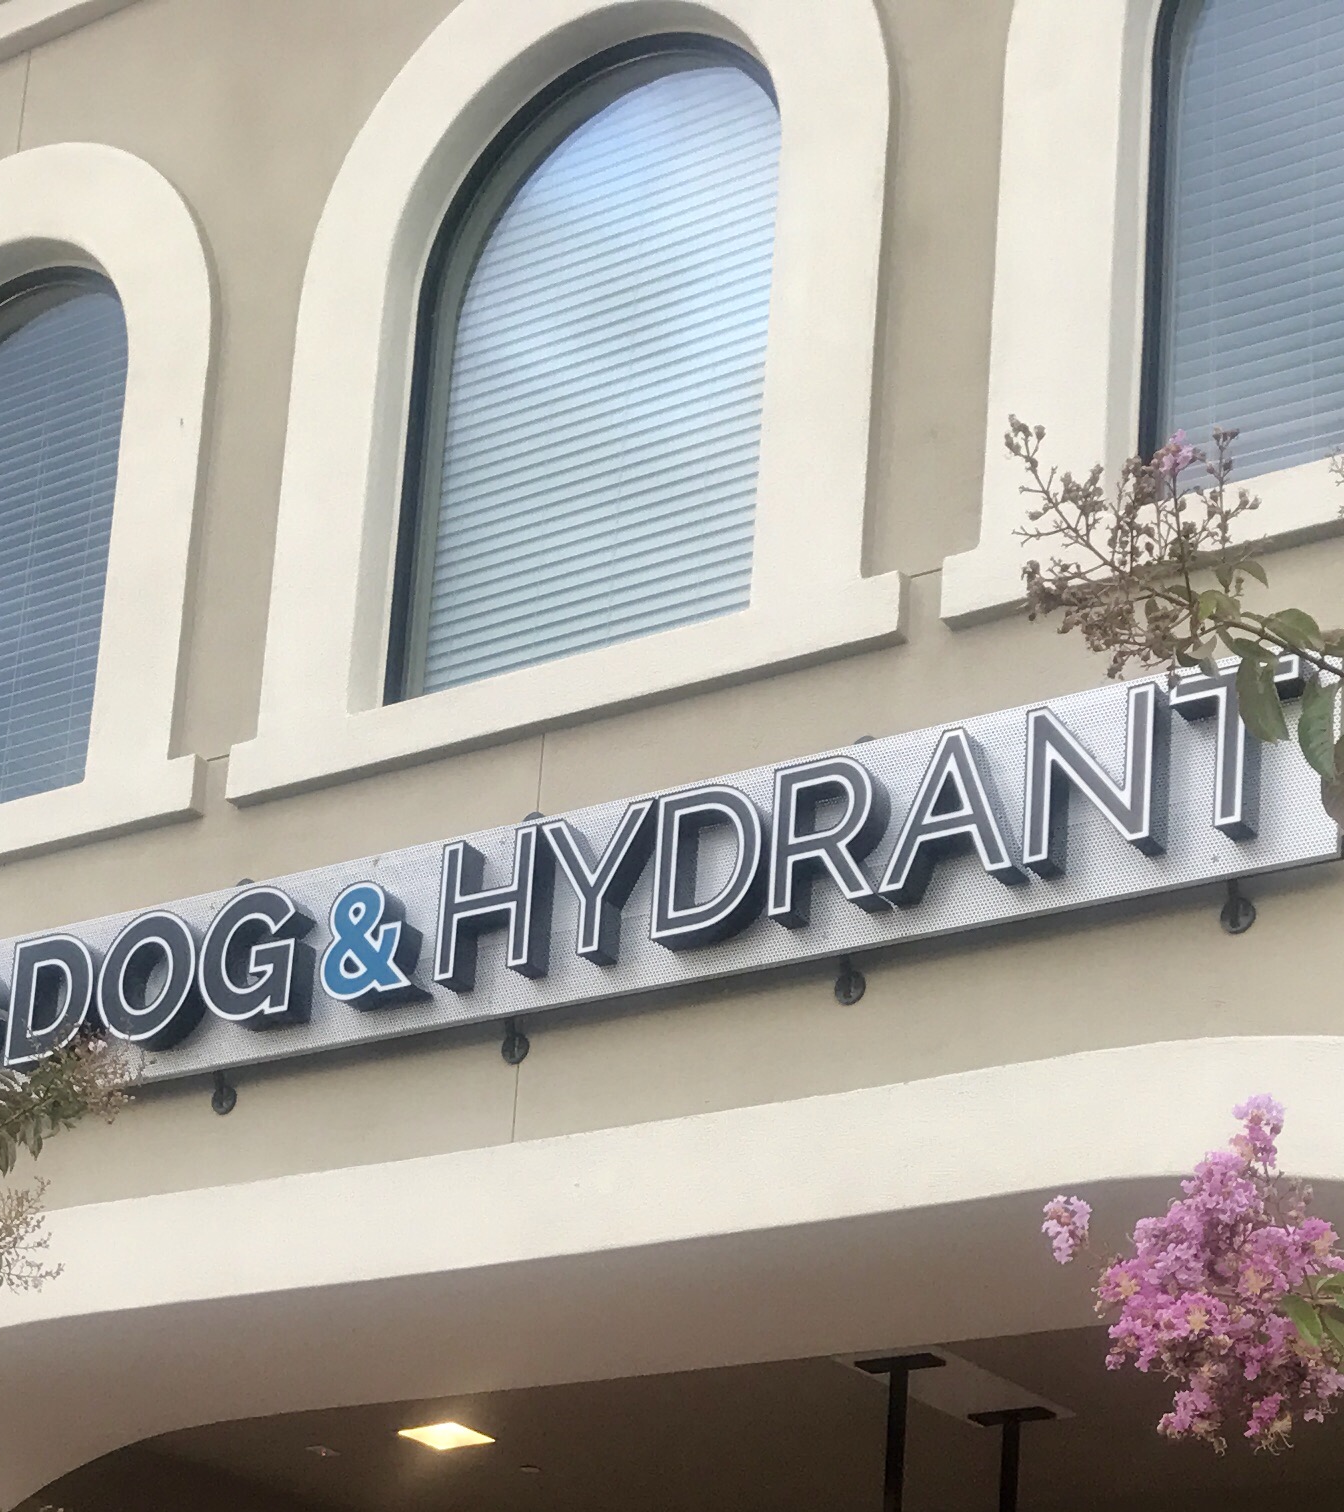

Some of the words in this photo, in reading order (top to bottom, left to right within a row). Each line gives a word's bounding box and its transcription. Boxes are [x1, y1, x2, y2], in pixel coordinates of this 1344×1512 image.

[3, 886, 298, 1067] DOG
[320, 880, 413, 1002] &
[433, 652, 1302, 984] HYDRANT
